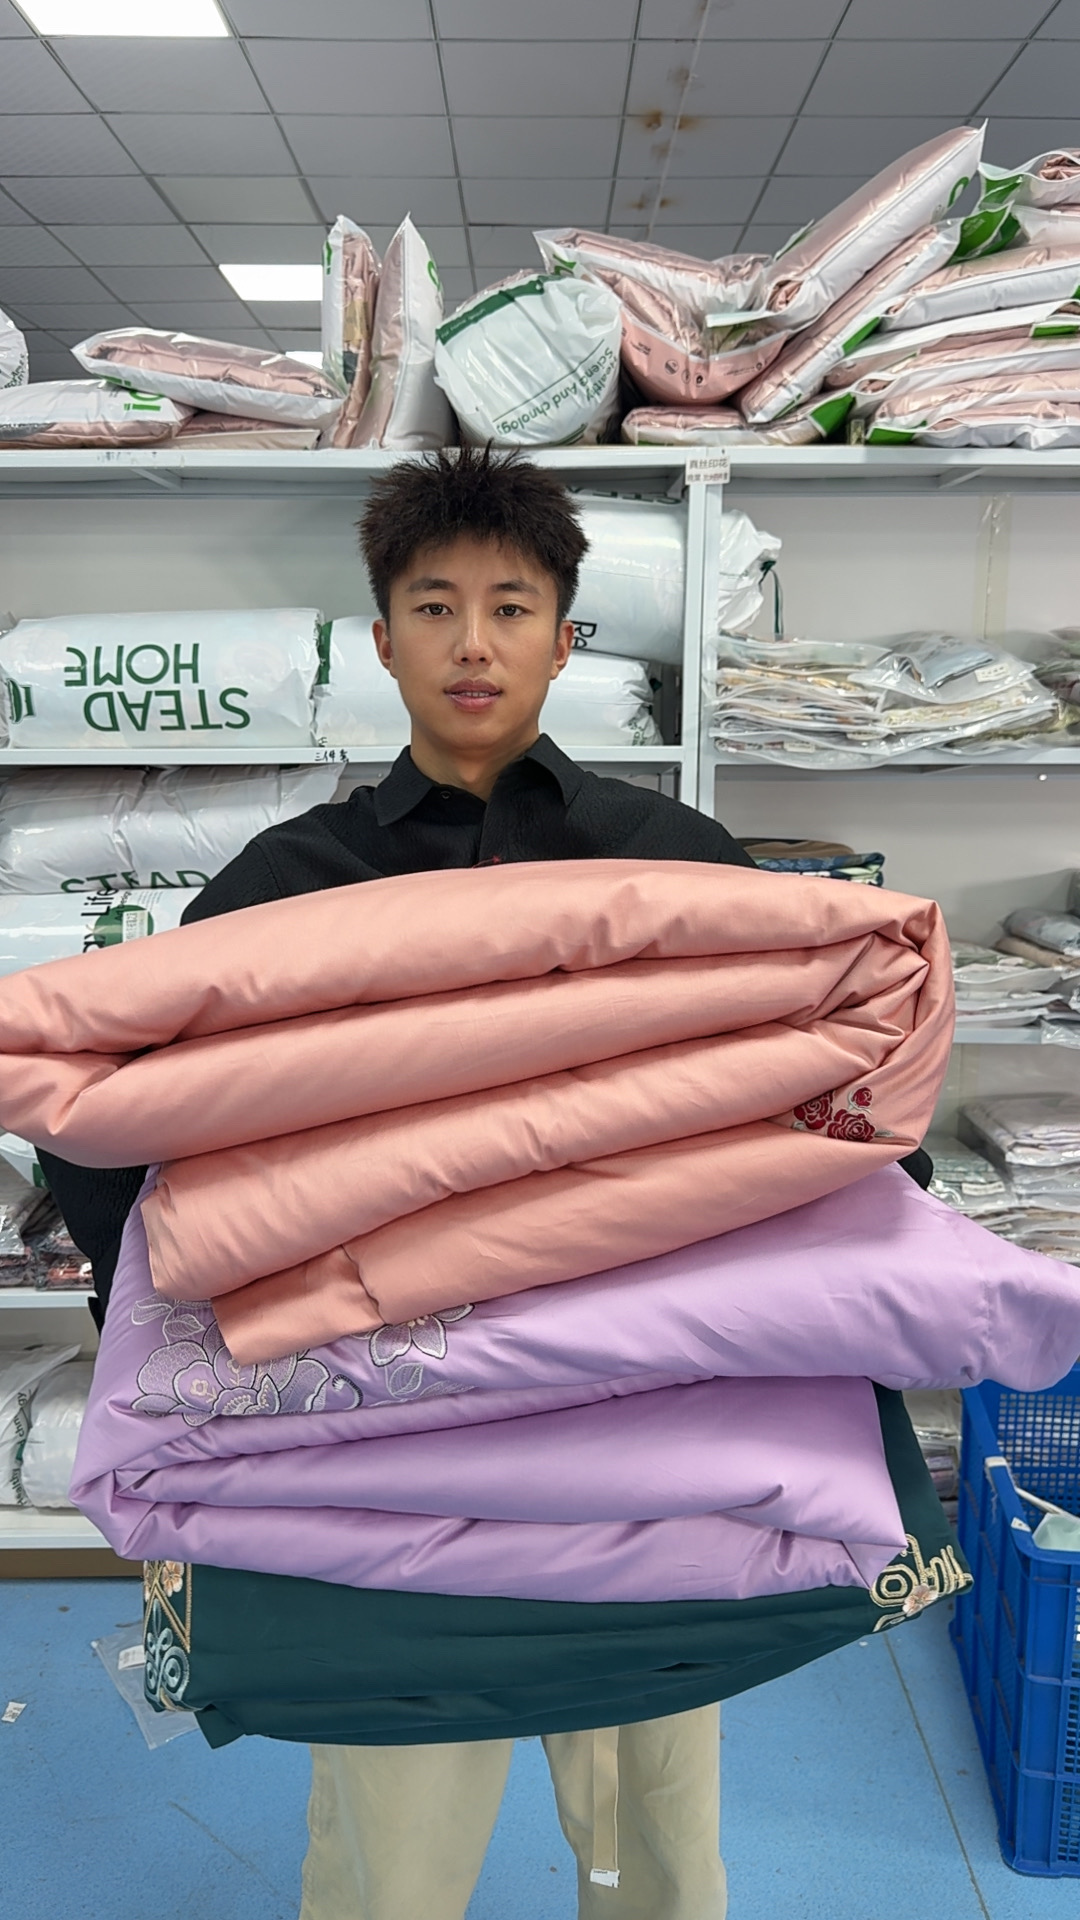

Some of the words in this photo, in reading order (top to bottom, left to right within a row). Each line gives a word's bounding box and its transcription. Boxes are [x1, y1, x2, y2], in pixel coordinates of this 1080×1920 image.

[552, 383, 578, 409] And
[64, 642, 200, 687] HOME
[83, 687, 251, 732] STEAD
[80, 888, 119, 917] Life
